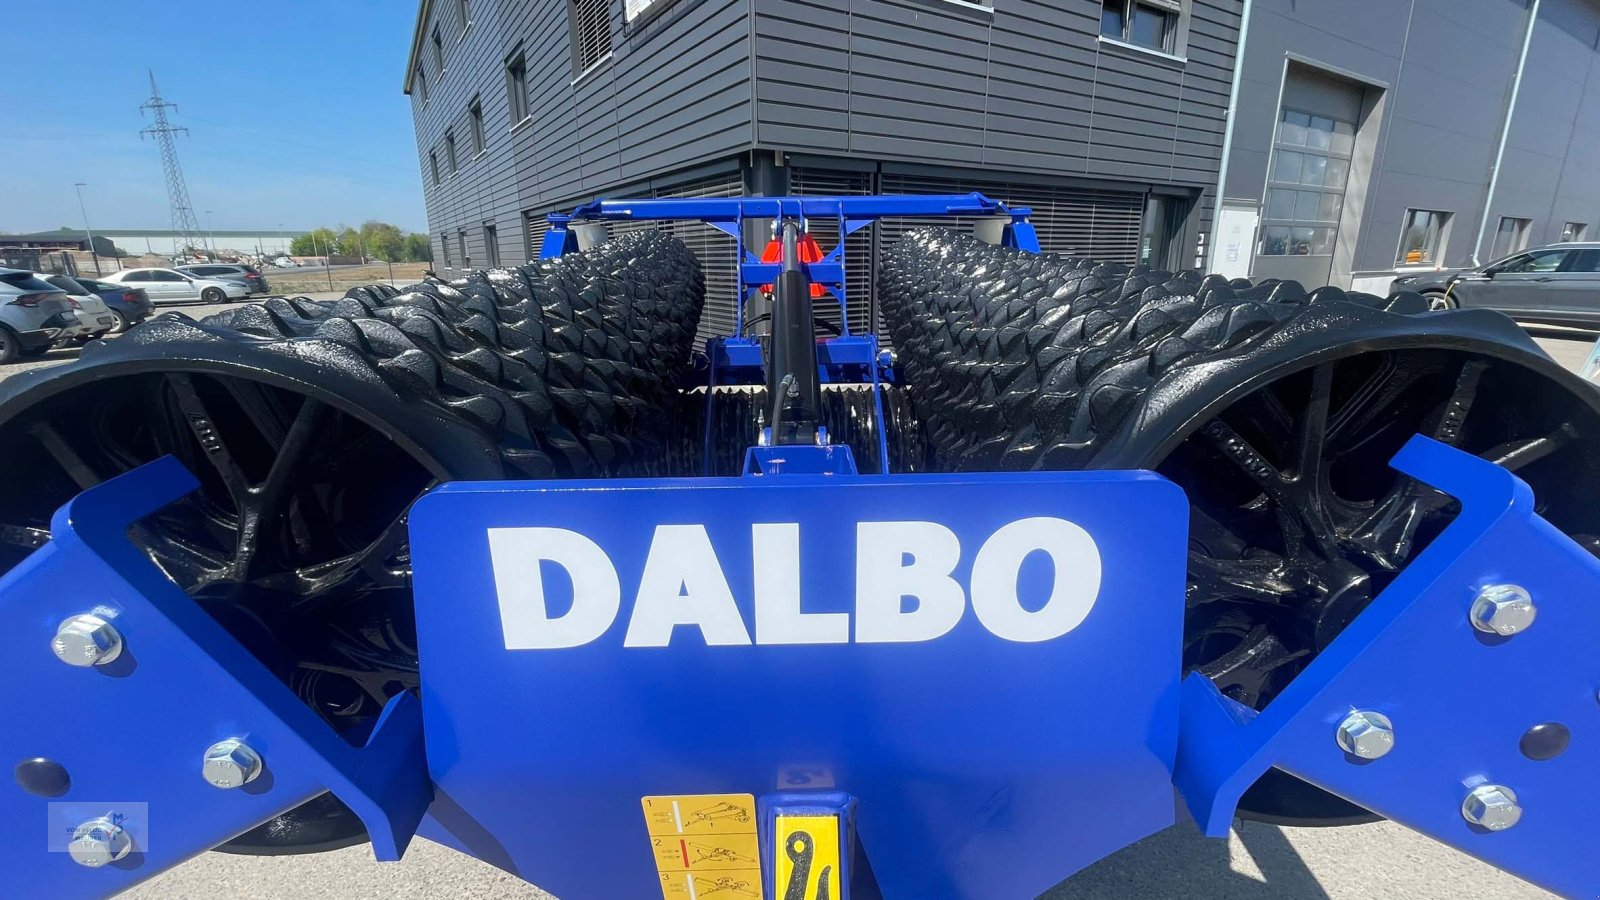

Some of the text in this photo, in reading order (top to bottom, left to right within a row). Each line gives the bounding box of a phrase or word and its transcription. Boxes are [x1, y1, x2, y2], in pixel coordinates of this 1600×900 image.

[487, 516, 1102, 650] DALBO
[654, 838, 662, 847] 2
[662, 873, 670, 881] 3
